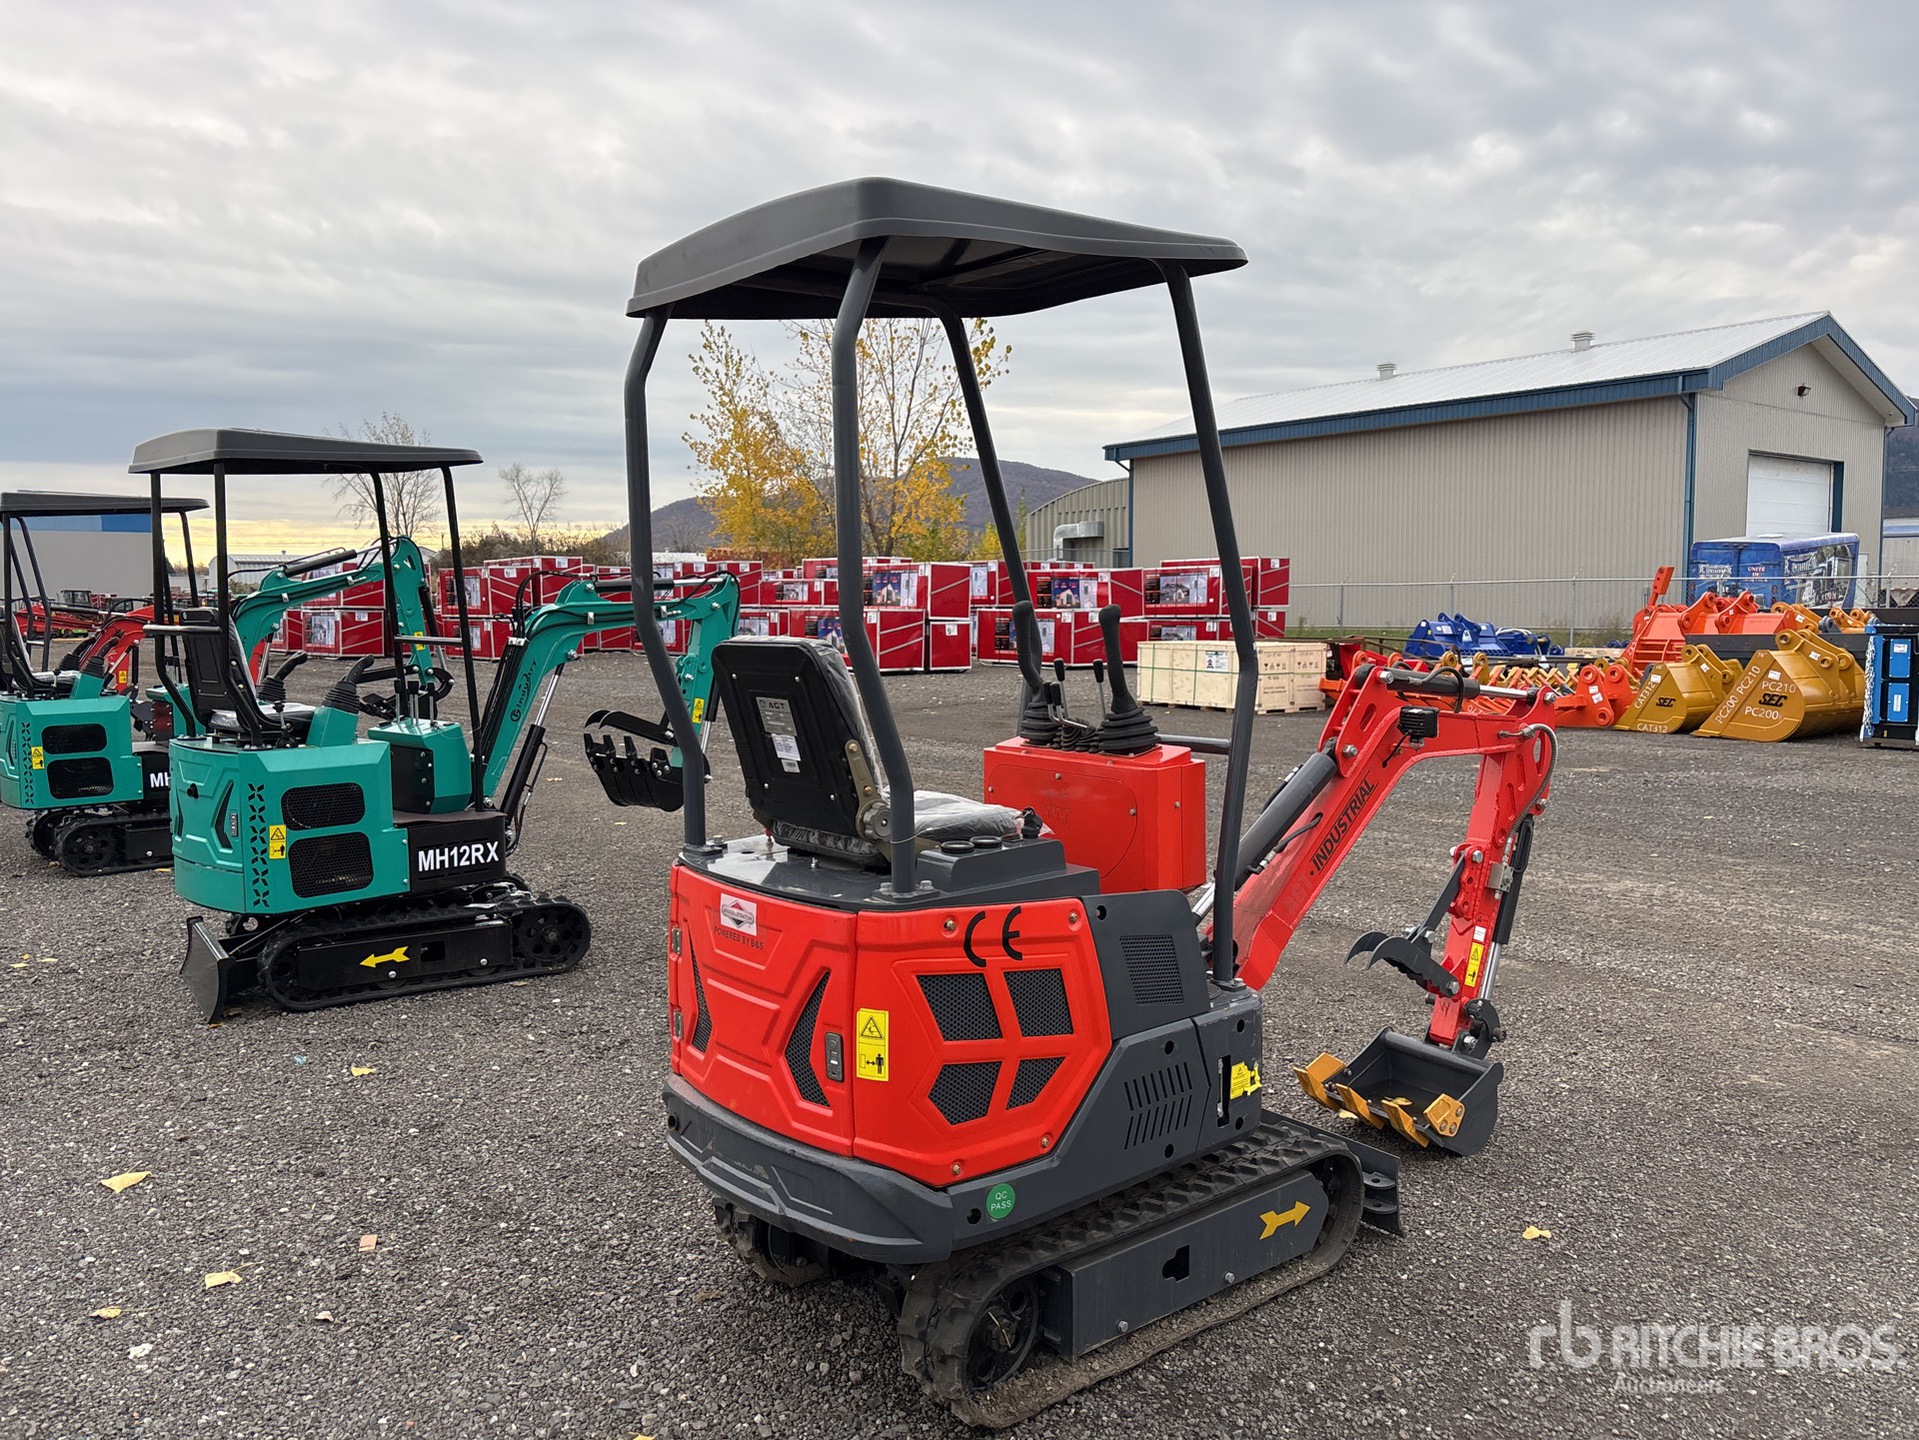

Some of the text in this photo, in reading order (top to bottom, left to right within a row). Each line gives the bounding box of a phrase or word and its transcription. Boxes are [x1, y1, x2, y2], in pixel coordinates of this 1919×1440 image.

[1736, 665, 1762, 695] PC210
[1761, 680, 1796, 694] PC210
[1656, 697, 1676, 708] SEC
[1758, 693, 1788, 707] SEC
[1744, 706, 1780, 720] PC200
[1636, 723, 1668, 733] CAT312
[1311, 779, 1375, 872] INDUSTRIAL
[418, 841, 500, 872] MH12RX
[714, 926, 741, 943] POWERED
[742, 935, 750, 946] BY
[995, 1191, 1008, 1200] QC
[991, 1199, 1012, 1211] PASS
